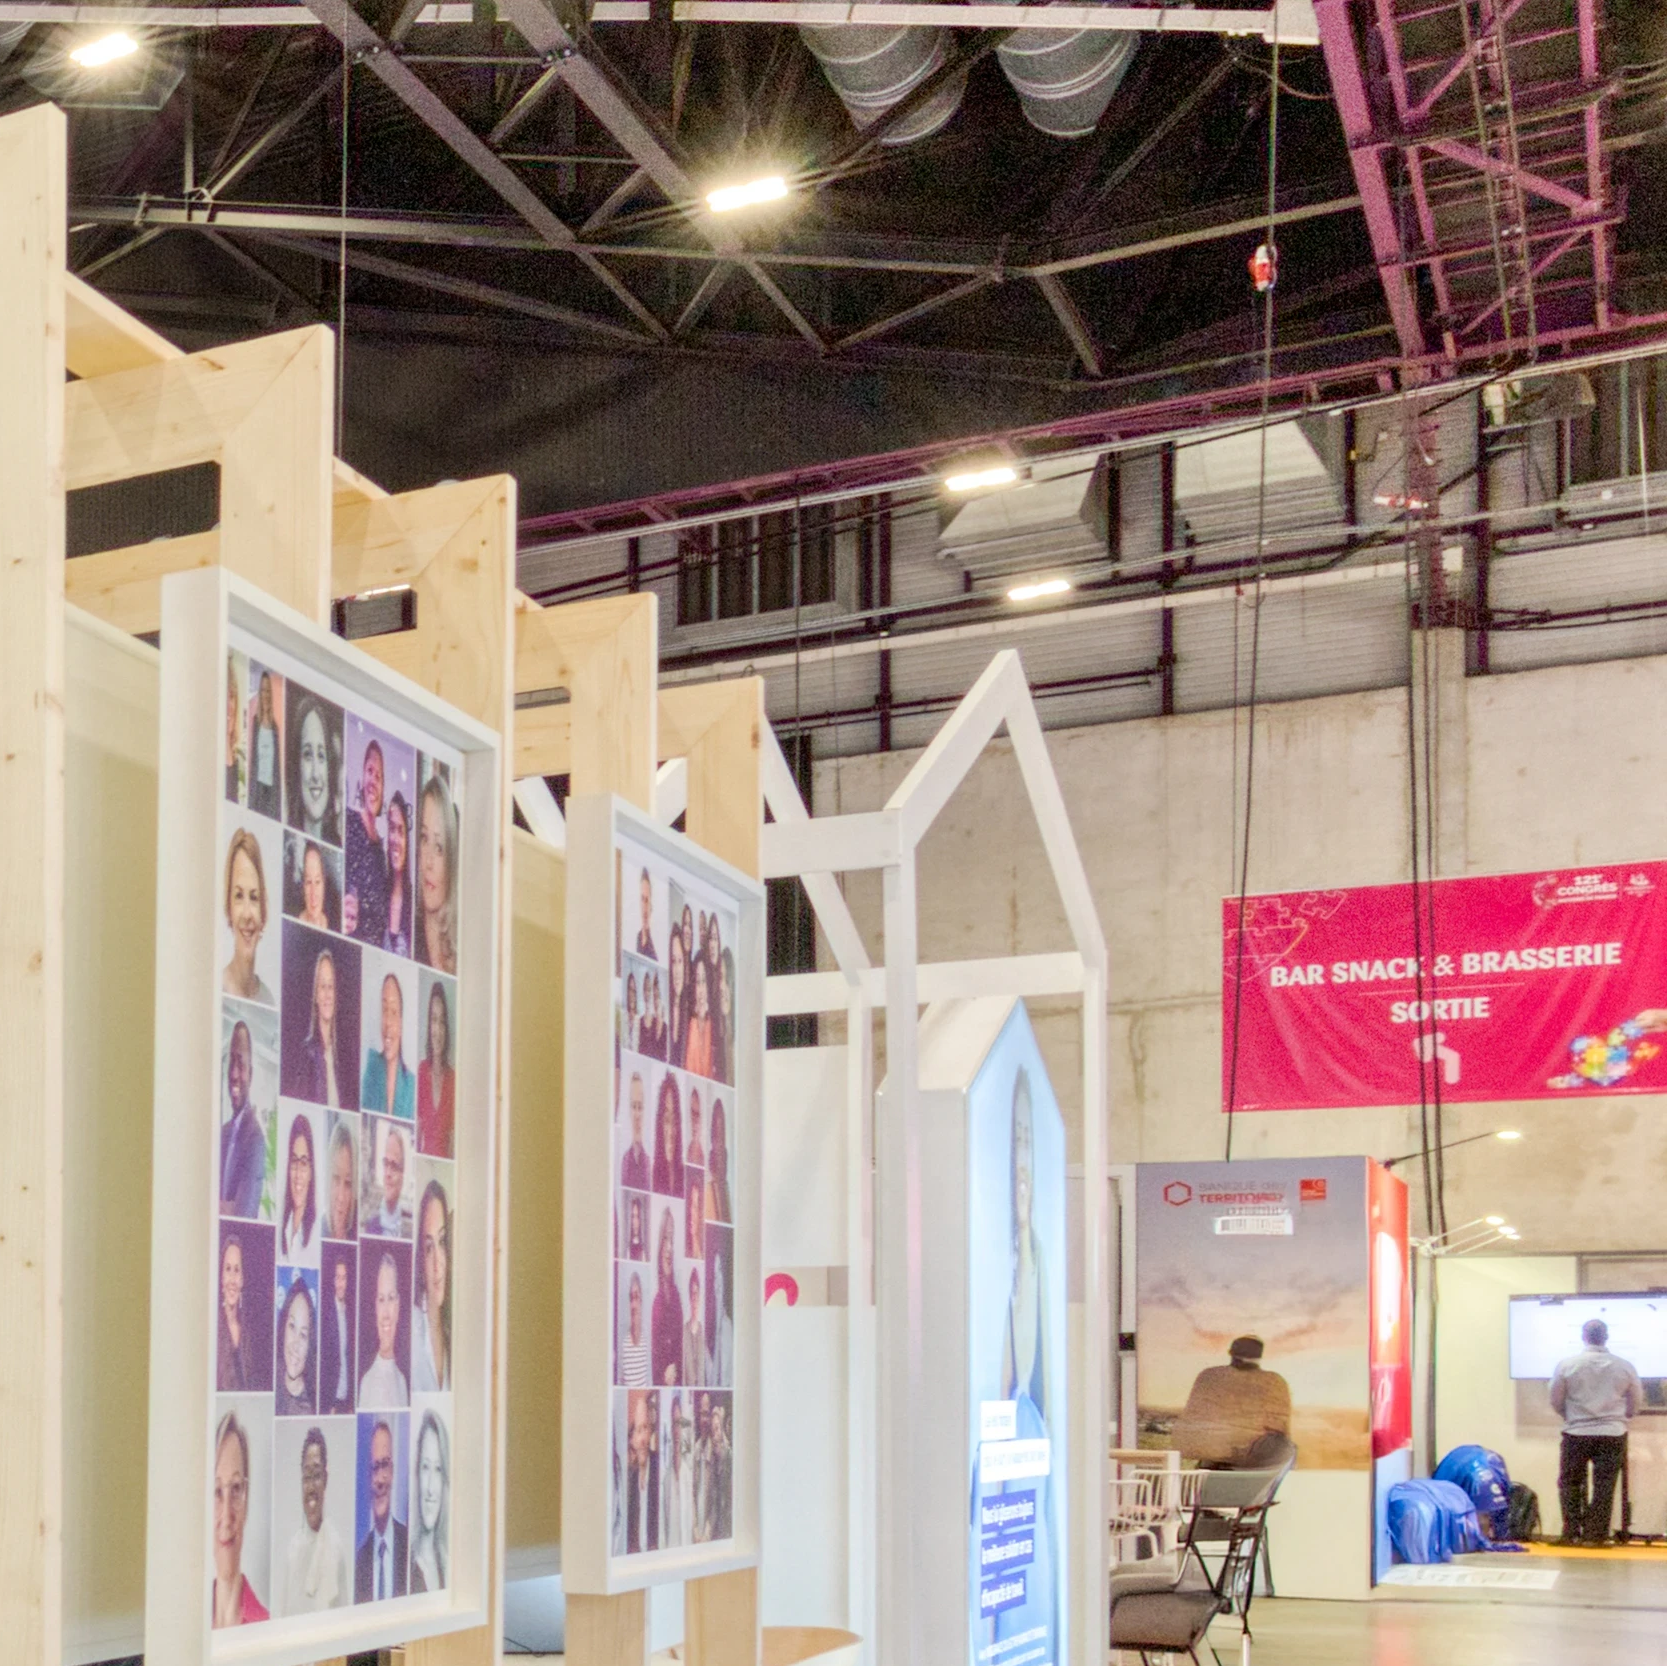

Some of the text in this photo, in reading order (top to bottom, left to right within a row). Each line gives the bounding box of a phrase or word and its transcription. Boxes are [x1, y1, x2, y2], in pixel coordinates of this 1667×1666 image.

[1270, 942, 1622, 988] BAR SNACK & BRASSERIE
[1390, 996, 1491, 1023] SORTIE
